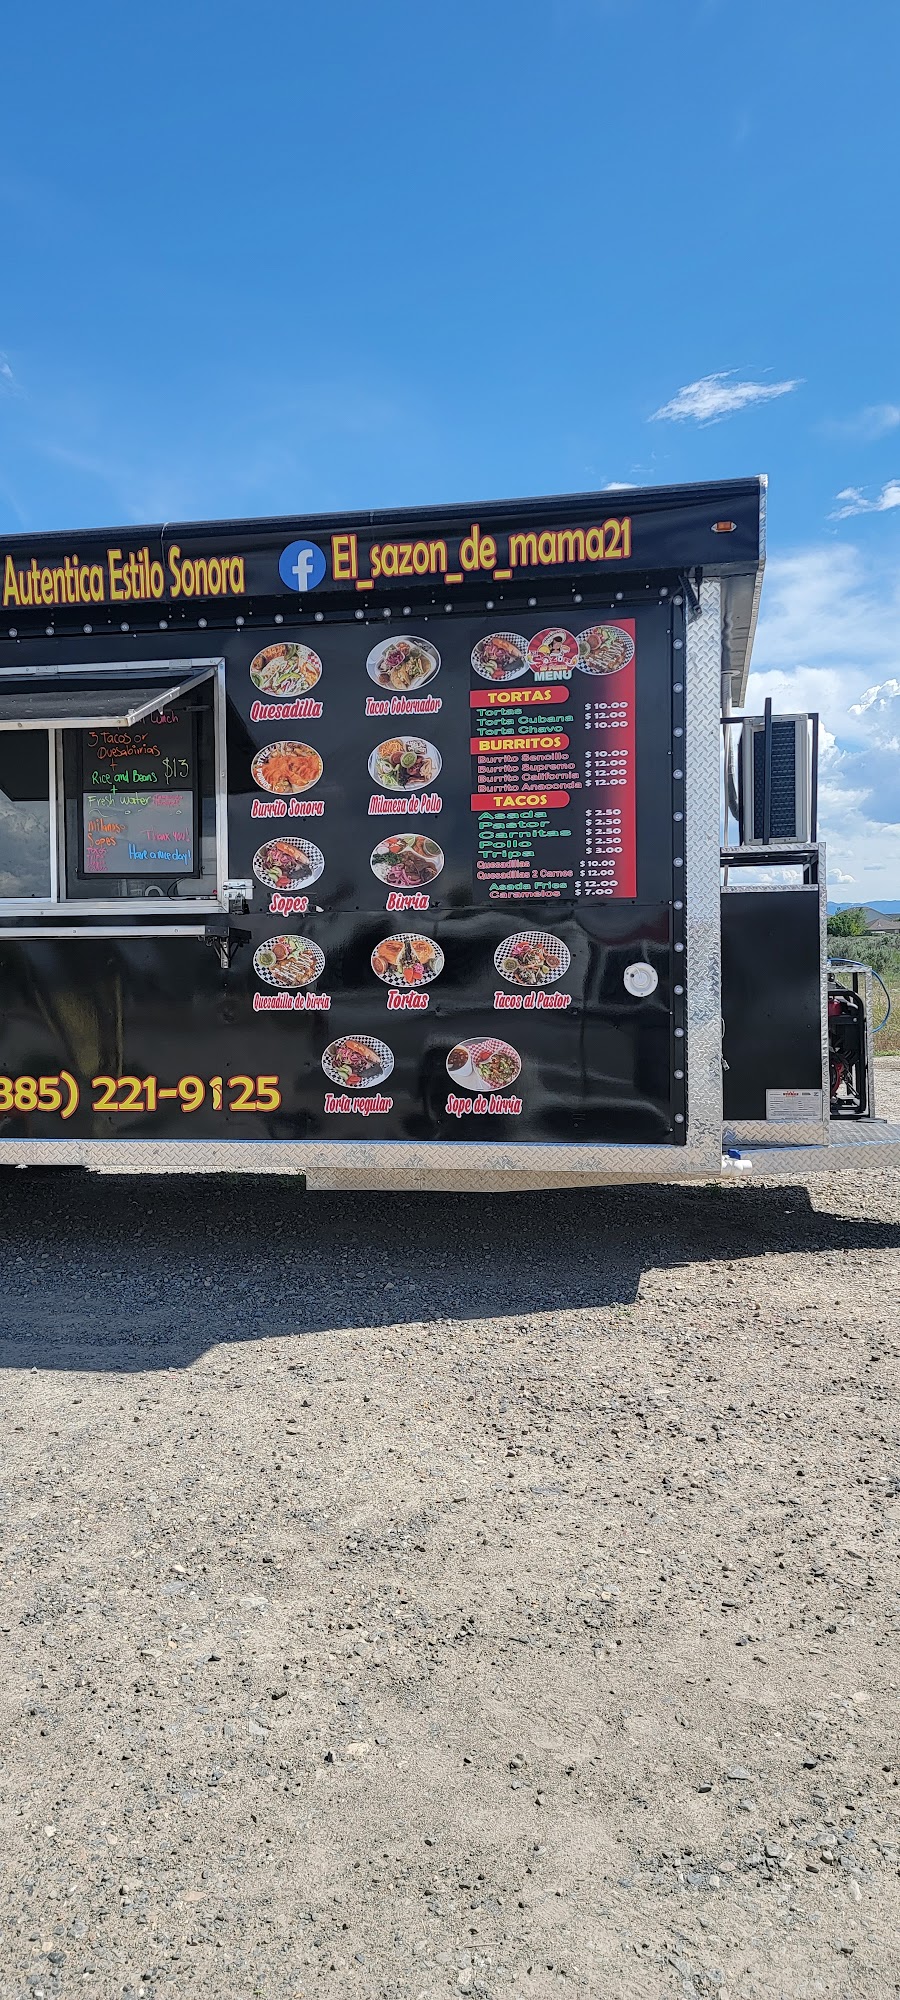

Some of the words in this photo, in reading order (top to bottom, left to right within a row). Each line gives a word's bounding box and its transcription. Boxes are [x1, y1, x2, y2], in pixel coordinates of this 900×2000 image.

[331, 517, 632, 591] El_sazon_de_mama21
[3, 555, 104, 606] Autentica
[107, 547, 164, 600] Estilo
[168, 545, 245, 598] Sonora
[534, 670, 572, 681] MENU
[488, 690, 551, 703] TORTAS
[250, 698, 323, 722] Quesadilla
[366, 697, 388, 716] Tacos
[390, 694, 442, 715] Gobernador
[477, 708, 522, 717] Tortas
[594, 711, 626, 719] 12.00
[477, 718, 514, 727] Torta
[518, 715, 574, 725] Cubana
[477, 728, 514, 736] Torta
[518, 726, 563, 734] Chavo
[88, 732, 98, 746] 3
[101, 732, 131, 744] Tacos
[134, 733, 148, 742] or
[479, 737, 561, 751] BURRITOS
[478, 755, 518, 764] Burrito
[521, 752, 569, 762] Sencillo
[162, 757, 189, 785] $13
[478, 765, 518, 773] Burrito
[521, 762, 575, 772] Supremo
[92, 771, 112, 784] Rice
[114, 770, 129, 782] and
[132, 770, 157, 783] Beans
[478, 774, 518, 783] Burrito
[521, 771, 579, 781] California
[478, 784, 518, 792] Burrito
[521, 781, 582, 791] Anaconda
[88, 794, 115, 807] Fresh
[368, 795, 407, 815] Milanesa
[408, 794, 419, 814] de
[420, 793, 442, 814] Pollo
[493, 794, 547, 807] TACOS
[251, 799, 287, 818] Burrito
[288, 798, 325, 816] Sonora
[478, 810, 547, 820] Asada
[478, 821, 550, 830] Pastor
[478, 830, 572, 839] Carnitas
[478, 840, 532, 849] Pollo
[478, 850, 535, 859] Tripa
[477, 860, 530, 869] Quesadillas
[477, 871, 530, 880] Quesadillas
[532, 870, 538, 878] 2
[540, 869, 573, 878] Carnes
[489, 882, 531, 891] Asada
[534, 881, 568, 890] Fries
[489, 890, 561, 898] Caramelos
[269, 893, 308, 917] Sopes
[386, 892, 430, 911] Birria
[253, 991, 294, 1010] Quesadilla
[294, 992, 304, 1009] de
[306, 992, 331, 1010] birria
[387, 989, 429, 1010] Tortas
[494, 991, 523, 1010] Tacos
[524, 992, 535, 1009] al
[536, 991, 572, 1009] Pastor
[91, 1075, 281, 1112] 221-9125
[324, 1093, 351, 1113] Torta
[353, 1094, 393, 1117] regular
[446, 1093, 471, 1118] Sope
[473, 1094, 488, 1114] de
[488, 1095, 523, 1115] birria
